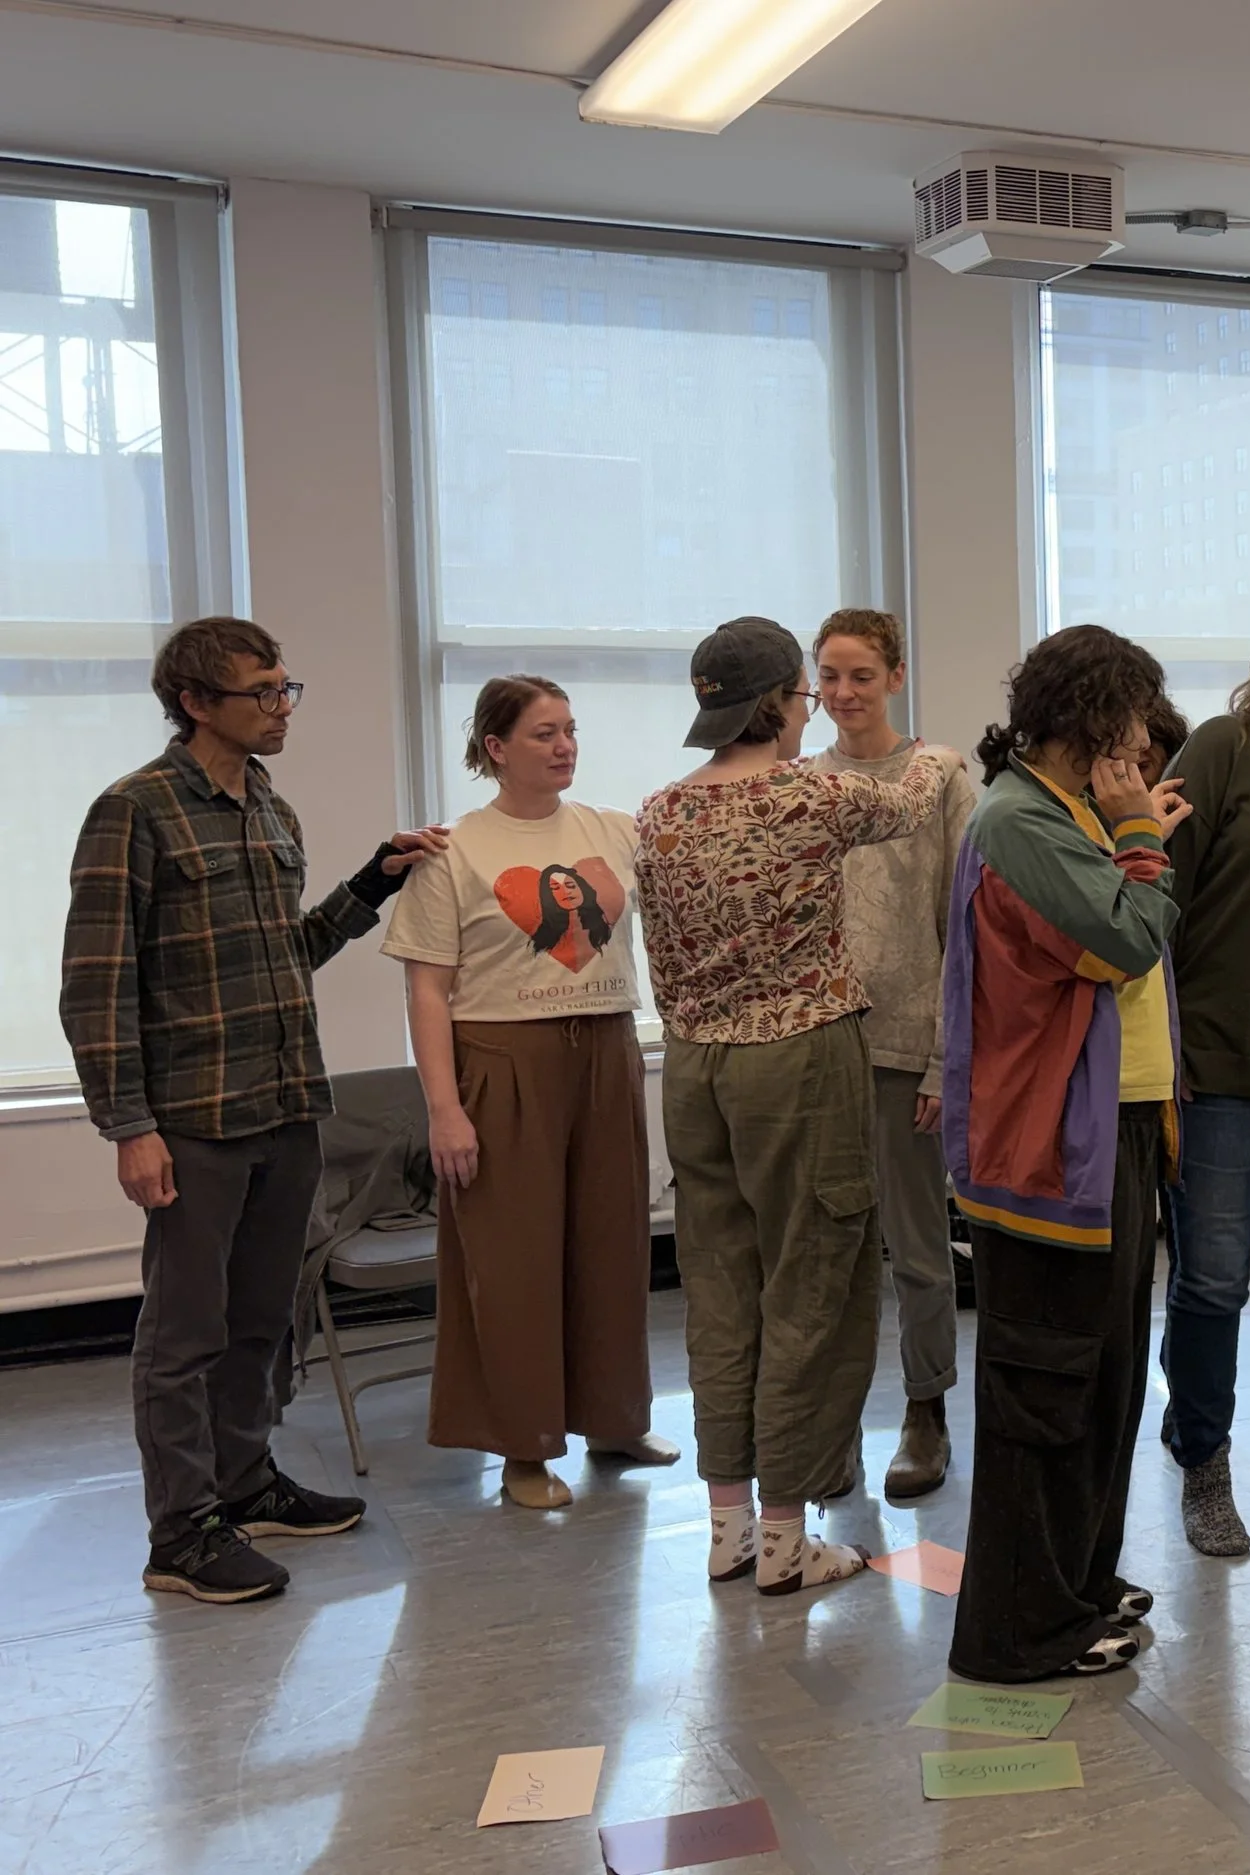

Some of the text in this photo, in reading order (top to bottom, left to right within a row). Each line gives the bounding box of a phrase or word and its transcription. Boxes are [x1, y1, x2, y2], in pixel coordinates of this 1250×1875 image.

[517, 979, 626, 1001] GOOD GRIEF
[937, 1759, 1048, 1780] Beginner
